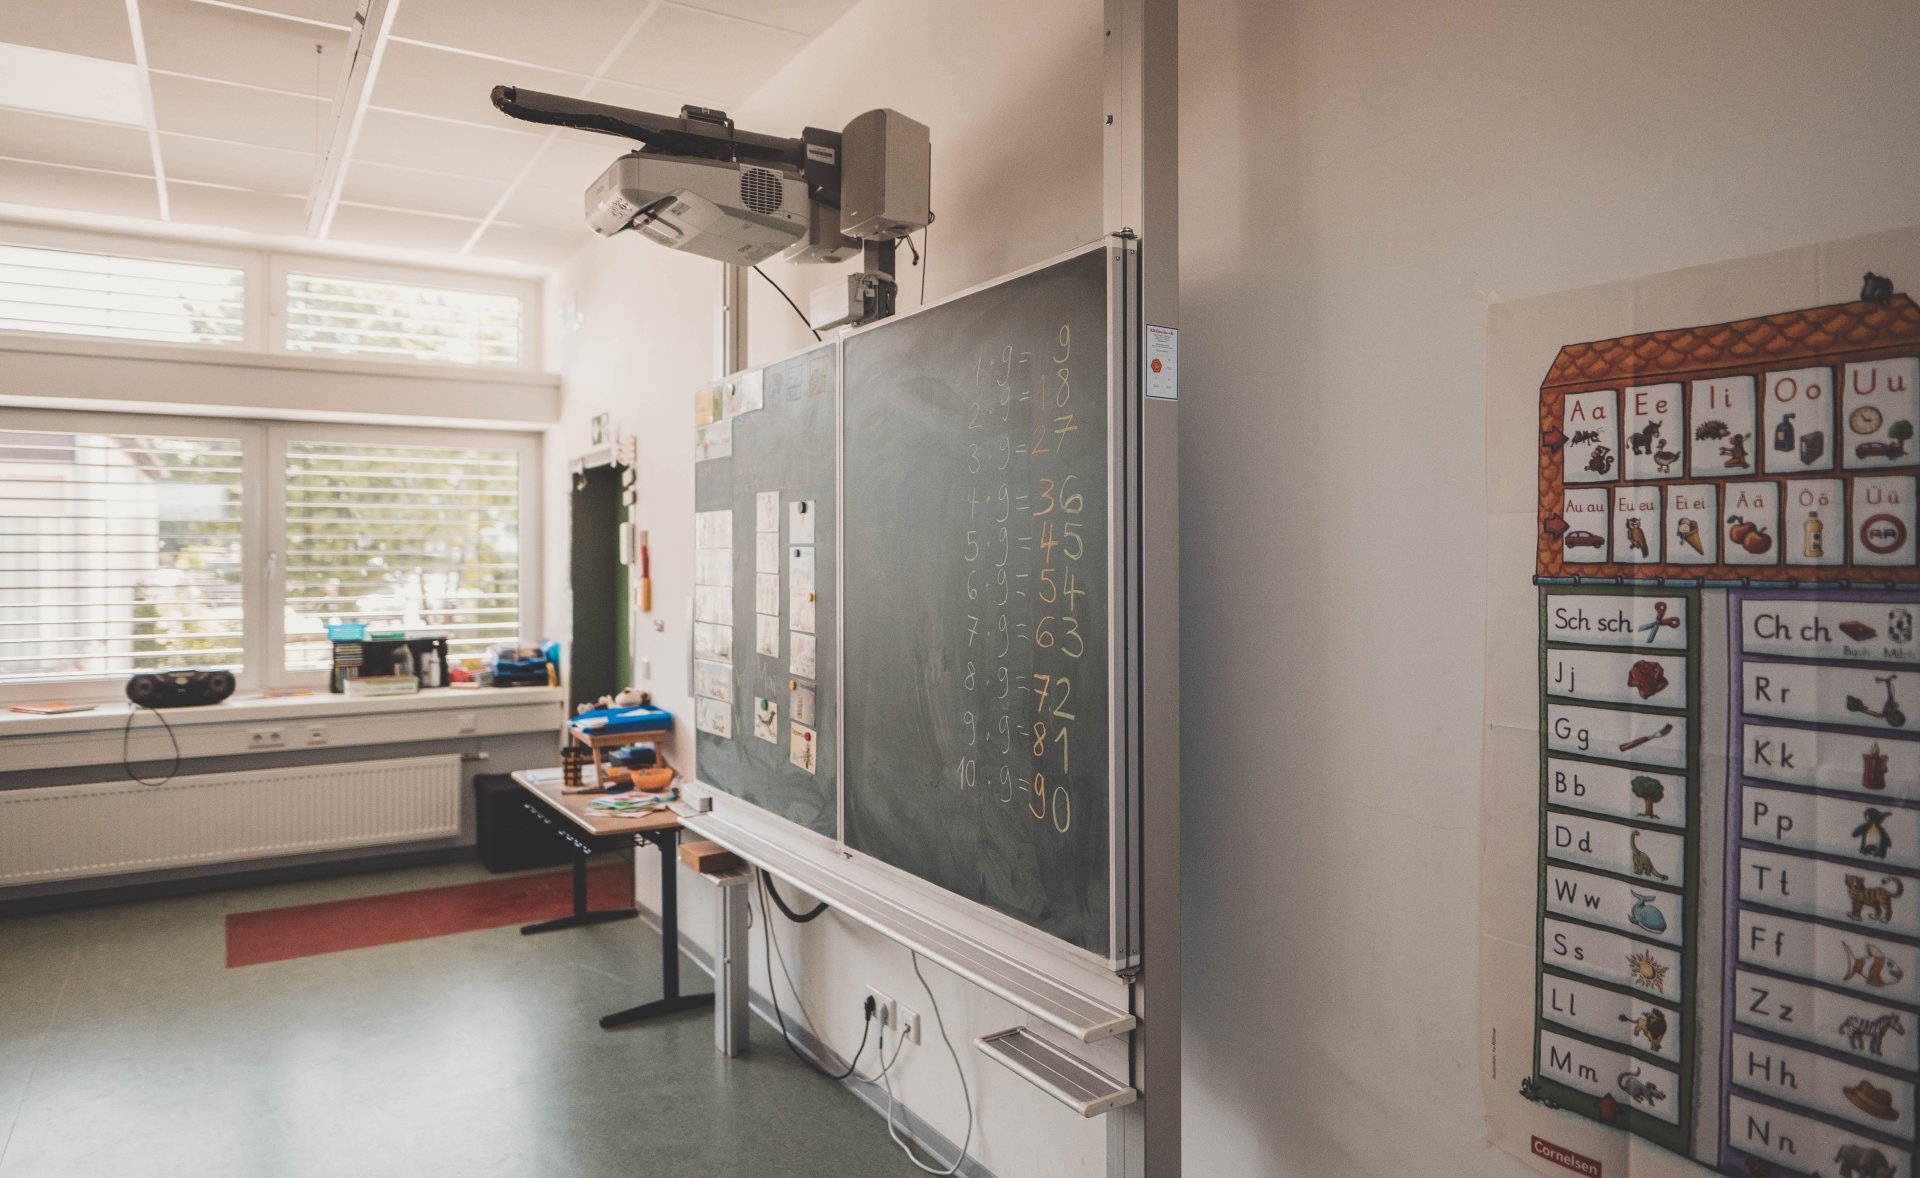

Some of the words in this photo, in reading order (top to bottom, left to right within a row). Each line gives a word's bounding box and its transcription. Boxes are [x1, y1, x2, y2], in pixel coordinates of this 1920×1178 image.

[1555, 609, 1590, 631] Sch
[1598, 610, 1632, 633] sch
[1754, 615, 1792, 640] Ch
[1801, 617, 1832, 642] ch
[1534, 1141, 1598, 1176] Cornelsen
